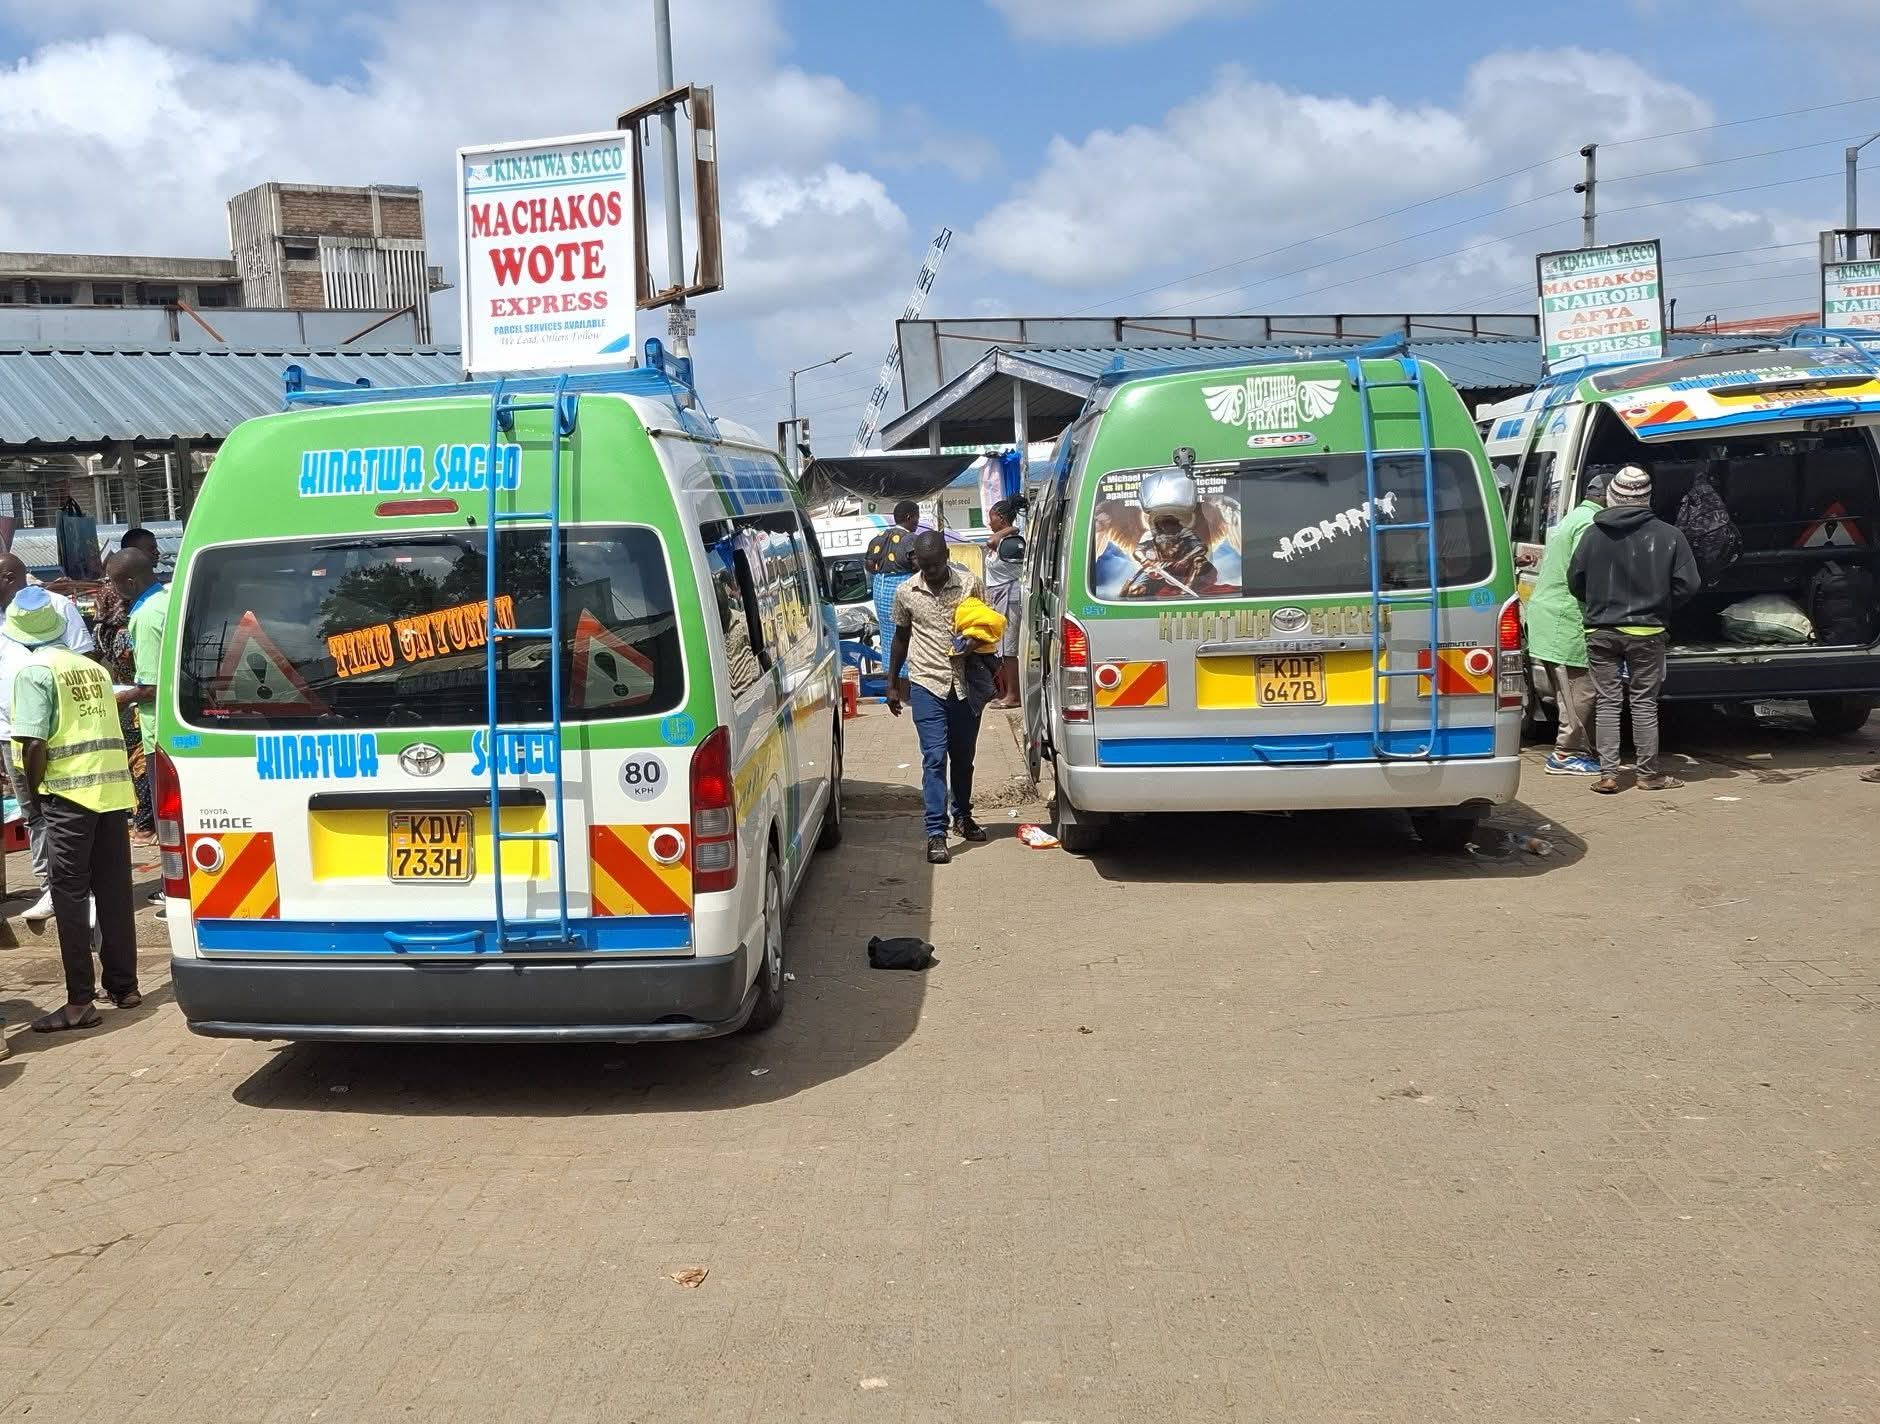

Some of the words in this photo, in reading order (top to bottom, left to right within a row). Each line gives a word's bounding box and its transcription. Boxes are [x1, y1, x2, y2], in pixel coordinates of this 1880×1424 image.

[494, 153, 565, 182] KINATWA
[571, 147, 622, 174] SACCO
[470, 191, 622, 238] MACHAKOS
[488, 240, 606, 287] WOTE
[1559, 248, 1613, 271] KINATWA
[1616, 244, 1655, 263] SACCO
[1543, 269, 1656, 295] MACHAKOS
[490, 291, 608, 317] EXPRESS
[1553, 285, 1649, 311] NAIROBI
[494, 325, 522, 335] PARCEL
[525, 321, 562, 333] SERVICES
[564, 319, 607, 331] AVAILABLE
[1572, 306, 1634, 325] AFYA
[1557, 318, 1651, 341] CENTRE
[1559, 334, 1652, 357] EXPRESS
[1247, 400, 1298, 430] PRAYER
[1253, 434, 1311, 445] STOP
[299, 446, 425, 497] KINATWA
[429, 444, 522, 493] SACCO
[1107, 474, 1140, 483] Michael
[1102, 483, 1113, 493] us
[1115, 482, 1123, 491] in
[1106, 491, 1137, 500] against
[1207, 485, 1224, 493] and
[1159, 608, 1271, 643] KINATWA
[328, 624, 395, 678] TIMU
[1273, 659, 1315, 679] KDT
[1263, 681, 1316, 701] 647B
[79, 702, 107, 718] Staff
[256, 733, 379, 780] KINATWA
[624, 761, 661, 785] 80
[634, 786, 654, 796] KPH
[200, 817, 253, 829] HIACE
[410, 816, 462, 844] KDV
[396, 849, 462, 876] 733H
